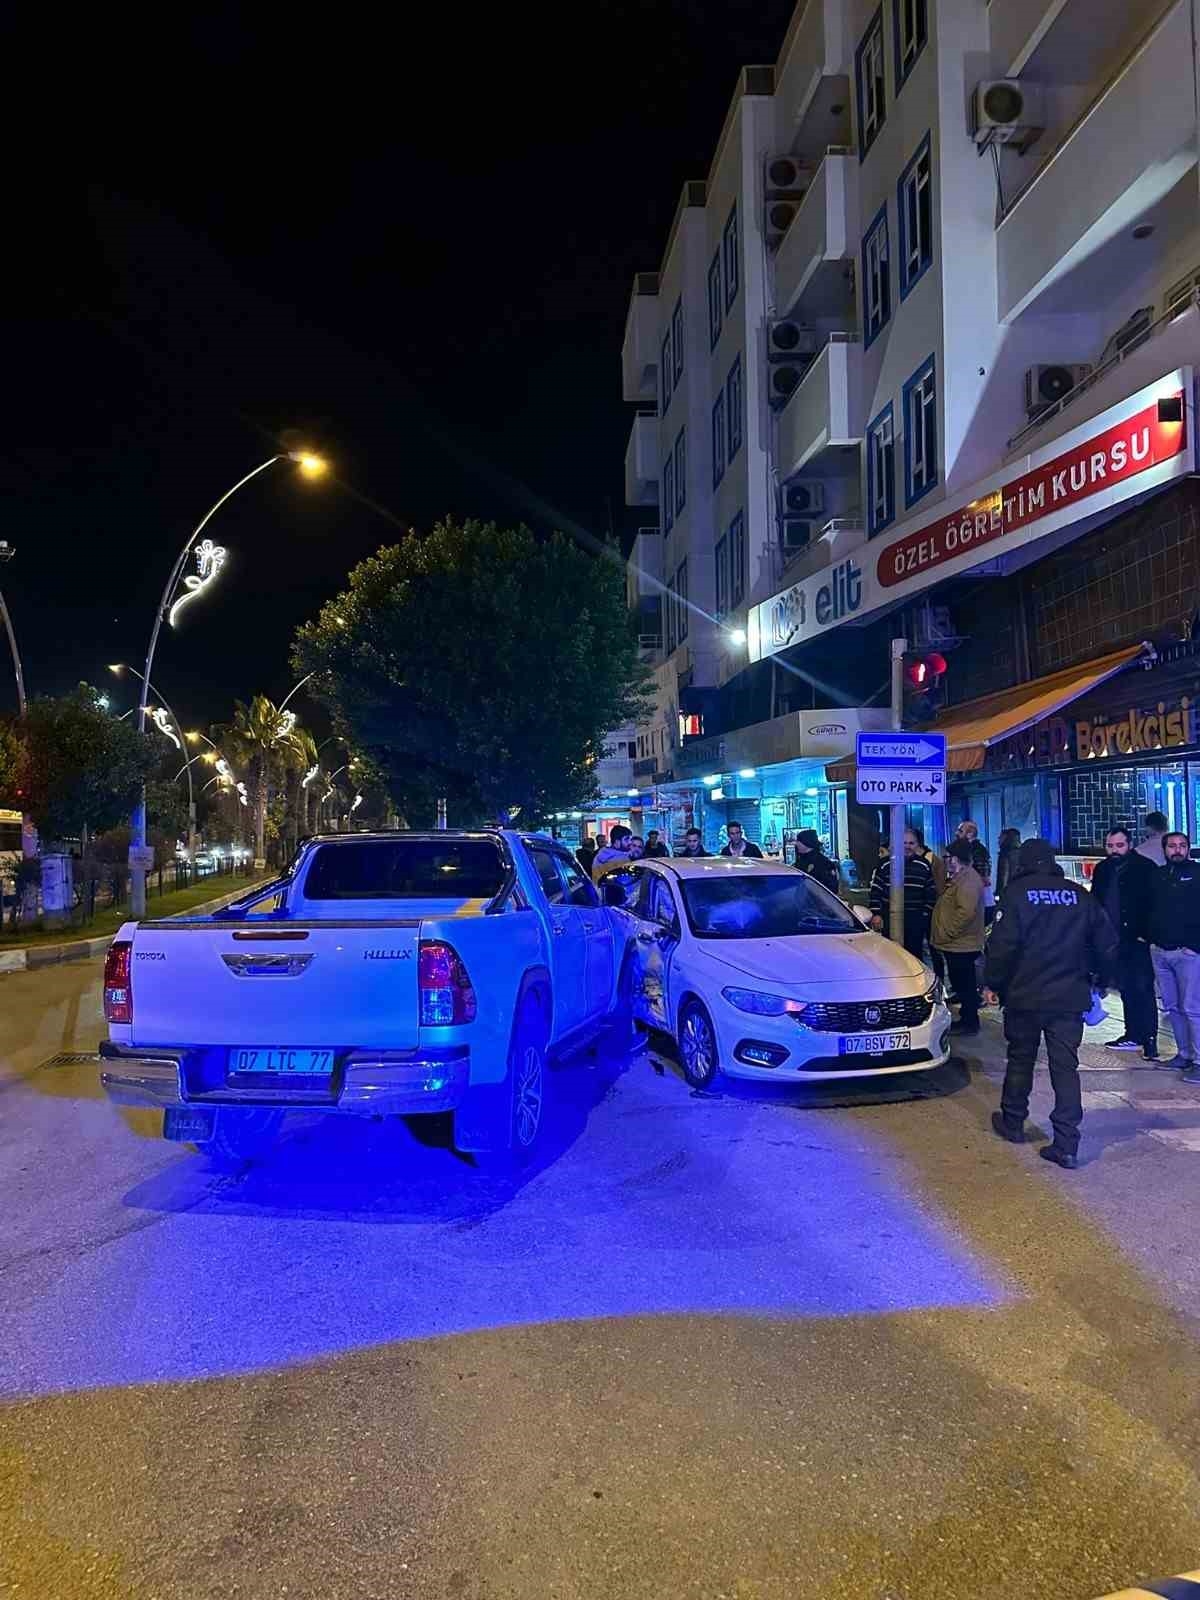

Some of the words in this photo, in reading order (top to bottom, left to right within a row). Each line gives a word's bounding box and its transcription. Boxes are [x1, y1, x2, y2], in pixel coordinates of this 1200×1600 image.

[894, 537, 940, 575] ÖZEL
[945, 484, 1045, 551] ÖĞRETİM
[1053, 427, 1149, 500] KURSU
[816, 559, 862, 625] elit
[864, 745, 886, 755] TEK
[891, 743, 915, 755] YÖN
[861, 781, 886, 792] OTO
[890, 781, 923, 793] PARK
[135, 952, 167, 961] TOYOTA
[363, 949, 412, 960] HILUX
[846, 1038, 861, 1052] 07
[865, 1036, 886, 1051] BSV
[889, 1034, 909, 1049] 572
[239, 1051, 258, 1070] 07
[267, 1051, 297, 1070] LTC
[310, 1051, 331, 1071] 77
